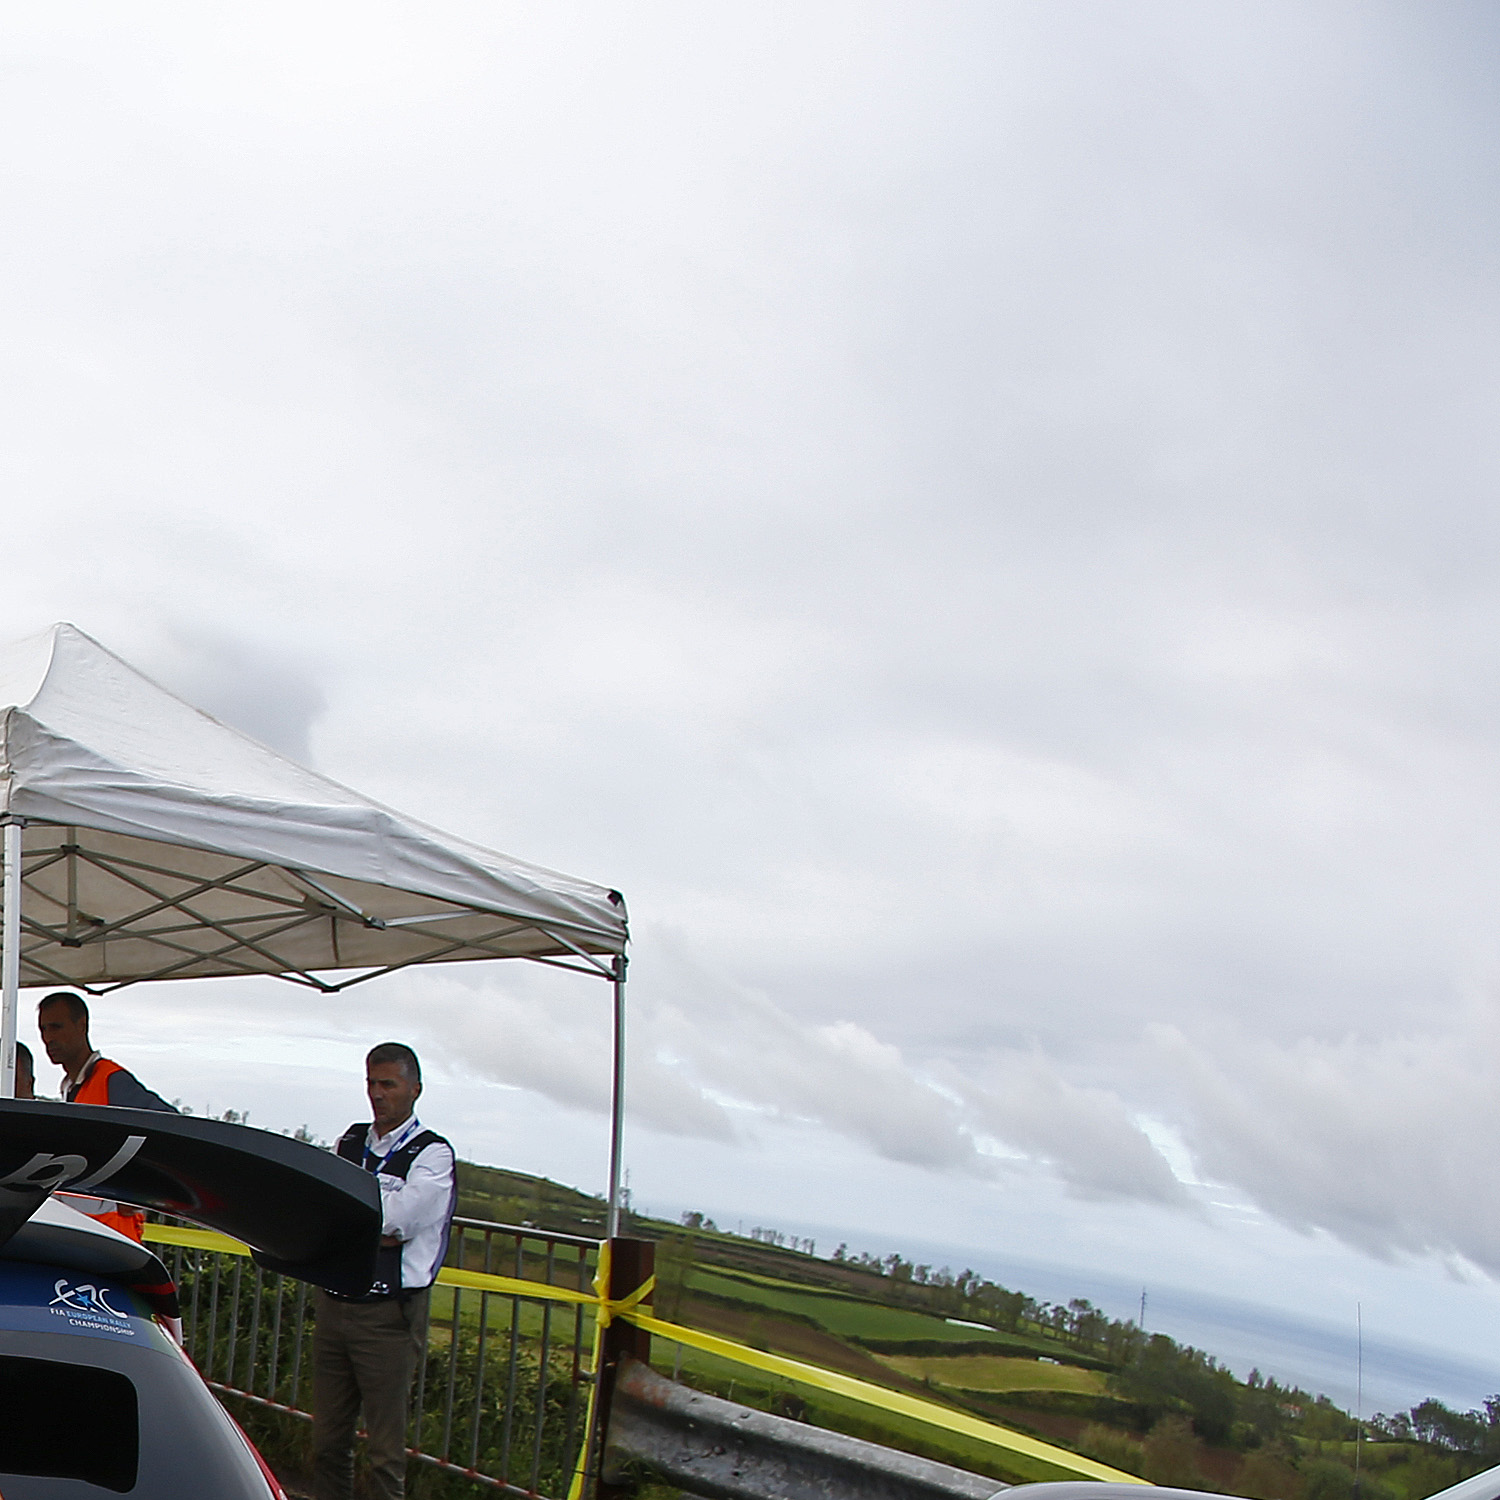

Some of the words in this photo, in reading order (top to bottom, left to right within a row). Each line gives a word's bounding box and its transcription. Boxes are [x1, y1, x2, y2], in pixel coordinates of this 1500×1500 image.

[50, 1307, 66, 1317] FIA
[66, 1310, 109, 1324] EUROPEAN
[68, 1318, 135, 1337] CHAMPIONSHIP
